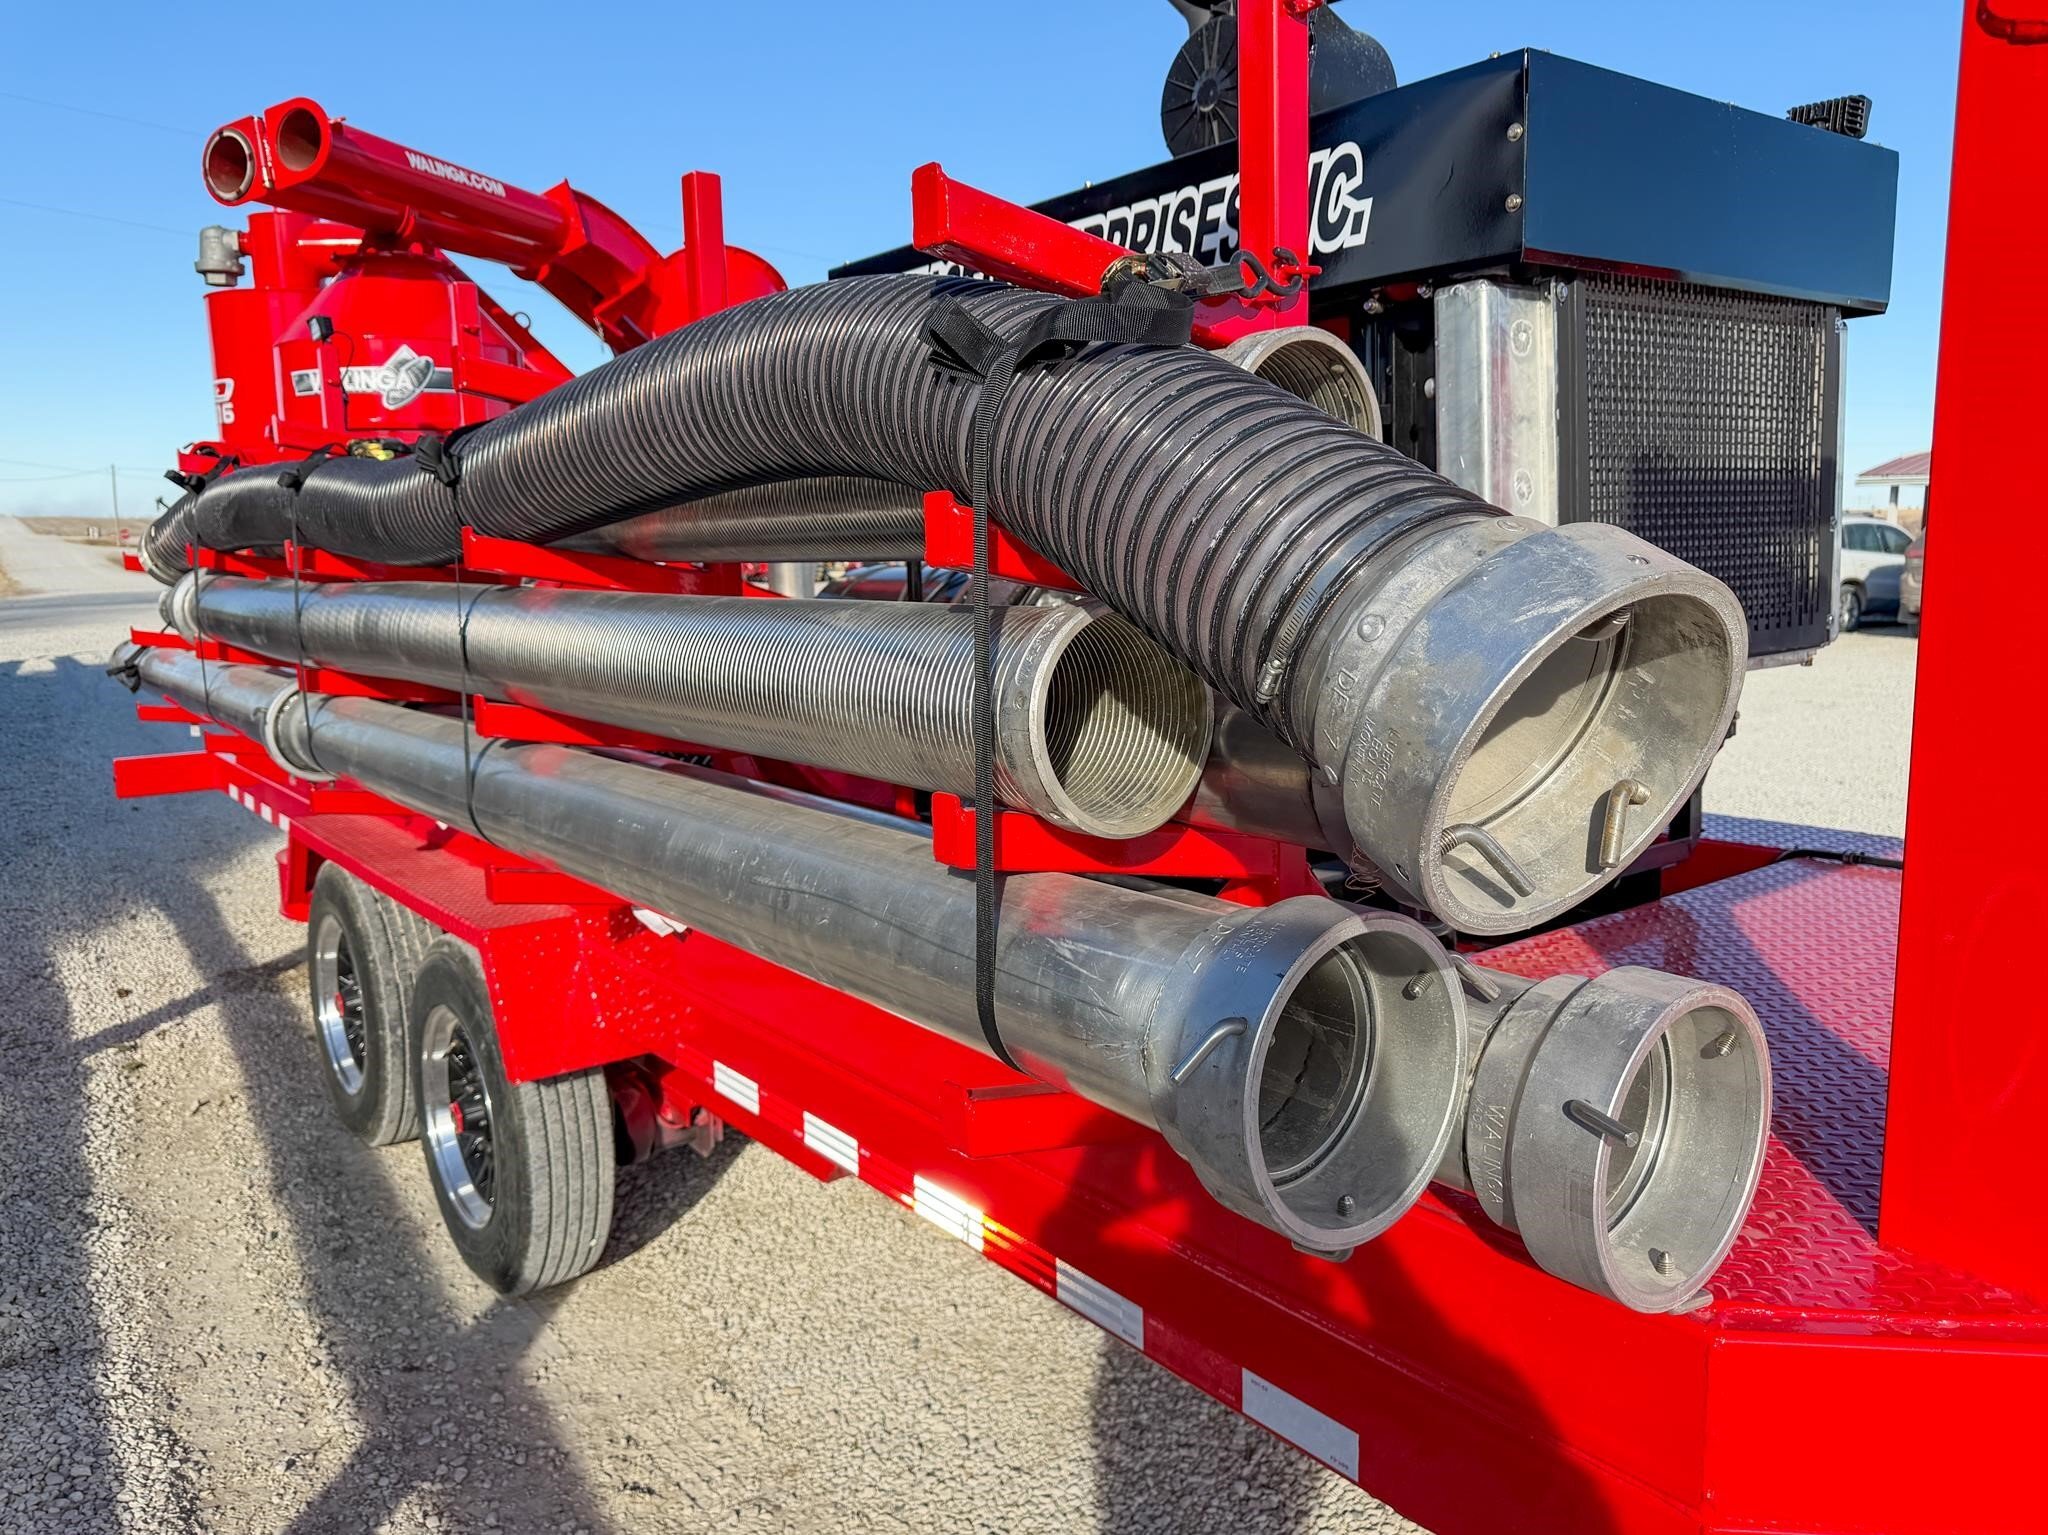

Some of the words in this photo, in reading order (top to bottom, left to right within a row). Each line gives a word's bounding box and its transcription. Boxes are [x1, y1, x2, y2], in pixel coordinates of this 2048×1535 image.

[404, 150, 506, 198] WALINGA.COM
[309, 367, 417, 394] WLINGA
[1482, 1104, 1507, 1203] WALINGA
